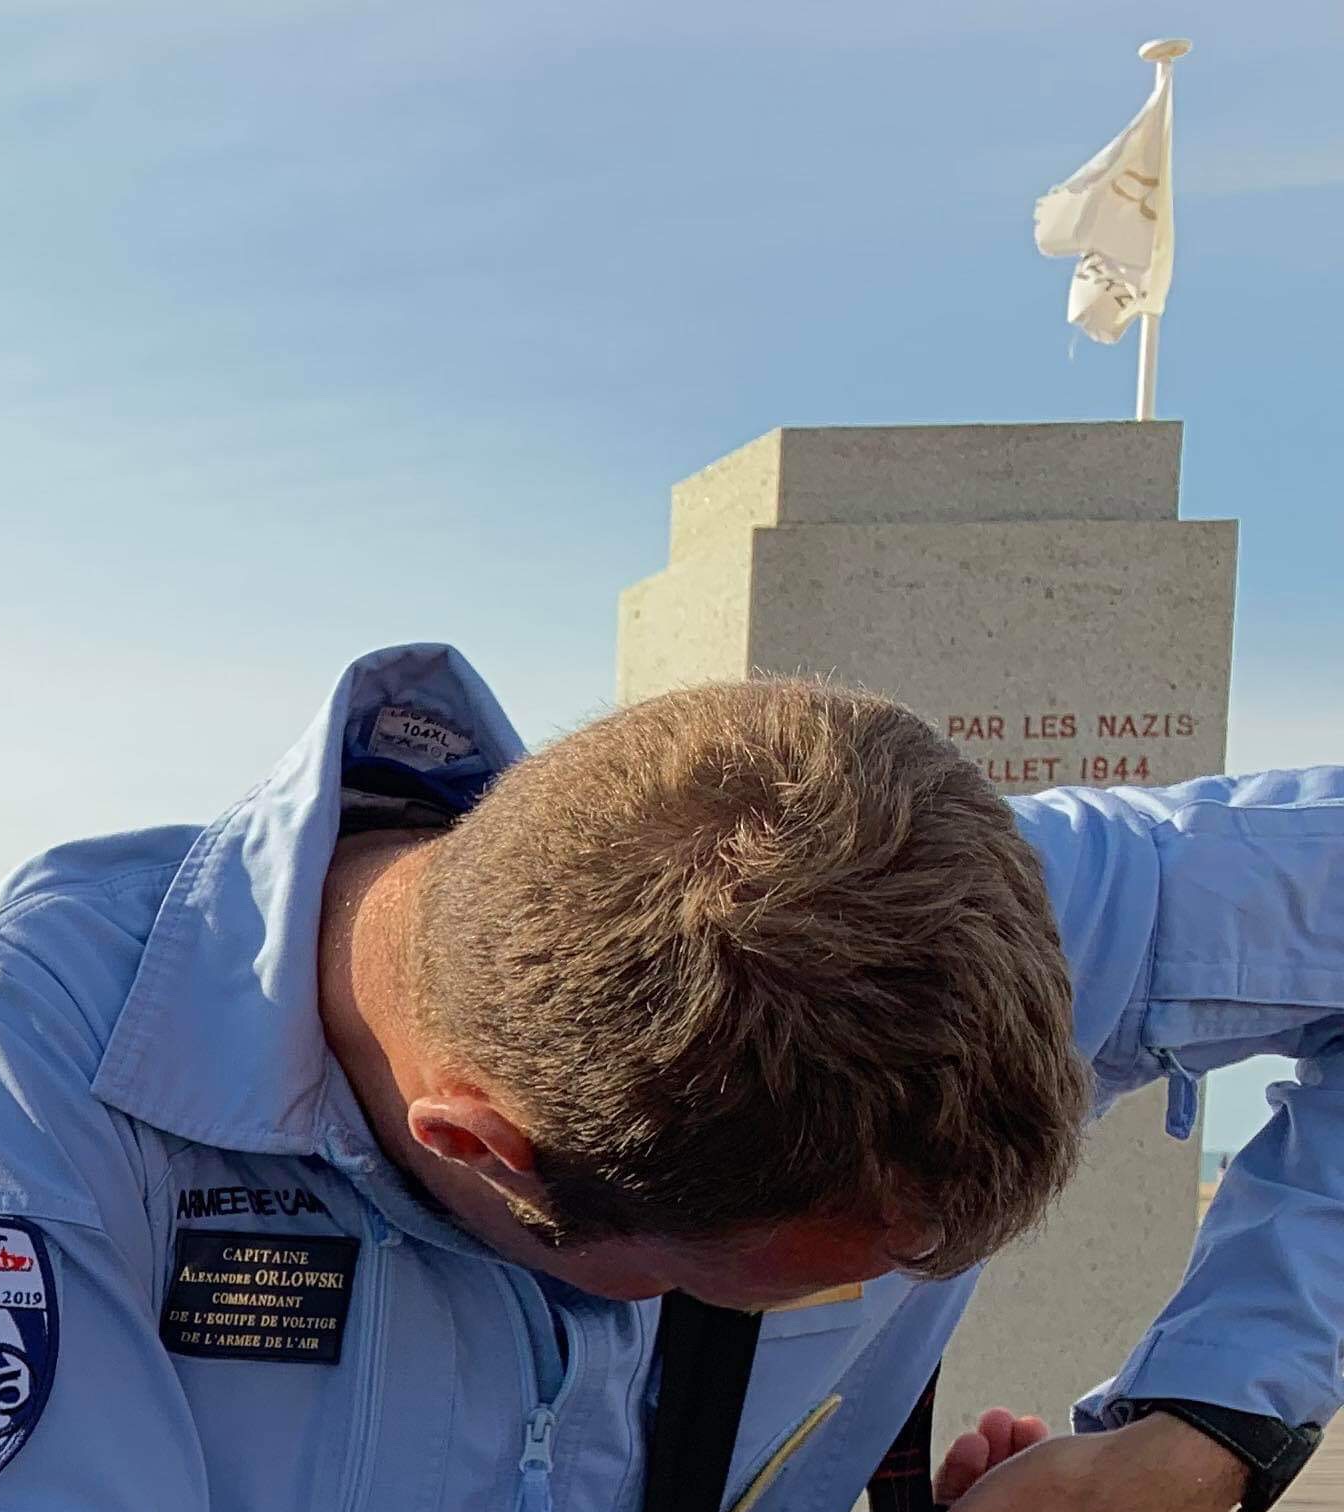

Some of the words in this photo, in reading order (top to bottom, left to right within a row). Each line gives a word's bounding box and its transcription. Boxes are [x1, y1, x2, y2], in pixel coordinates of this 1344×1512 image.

[947, 715, 1005, 740] PAR
[1022, 715, 1078, 739] LES
[1097, 713, 1195, 738] NAZIS
[987, 757, 1061, 783] LLET
[1080, 753, 1150, 780] 1944
[223, 1247, 310, 1265] CAPITAINE
[254, 1270, 345, 1289] ORLOWSKI
[2, 1290, 42, 1305] 2019
[212, 1292, 303, 1308] COMMANDANT
[169, 1310, 189, 1321] DE
[194, 1312, 256, 1327] L'EQUIPE
[261, 1314, 278, 1327] DE
[282, 1316, 337, 1330] VOLTIGE
[181, 1331, 201, 1342] DE
[204, 1332, 261, 1348] L'ARMEE
[265, 1336, 282, 1348] DE
[286, 1336, 320, 1349] L'AIR
